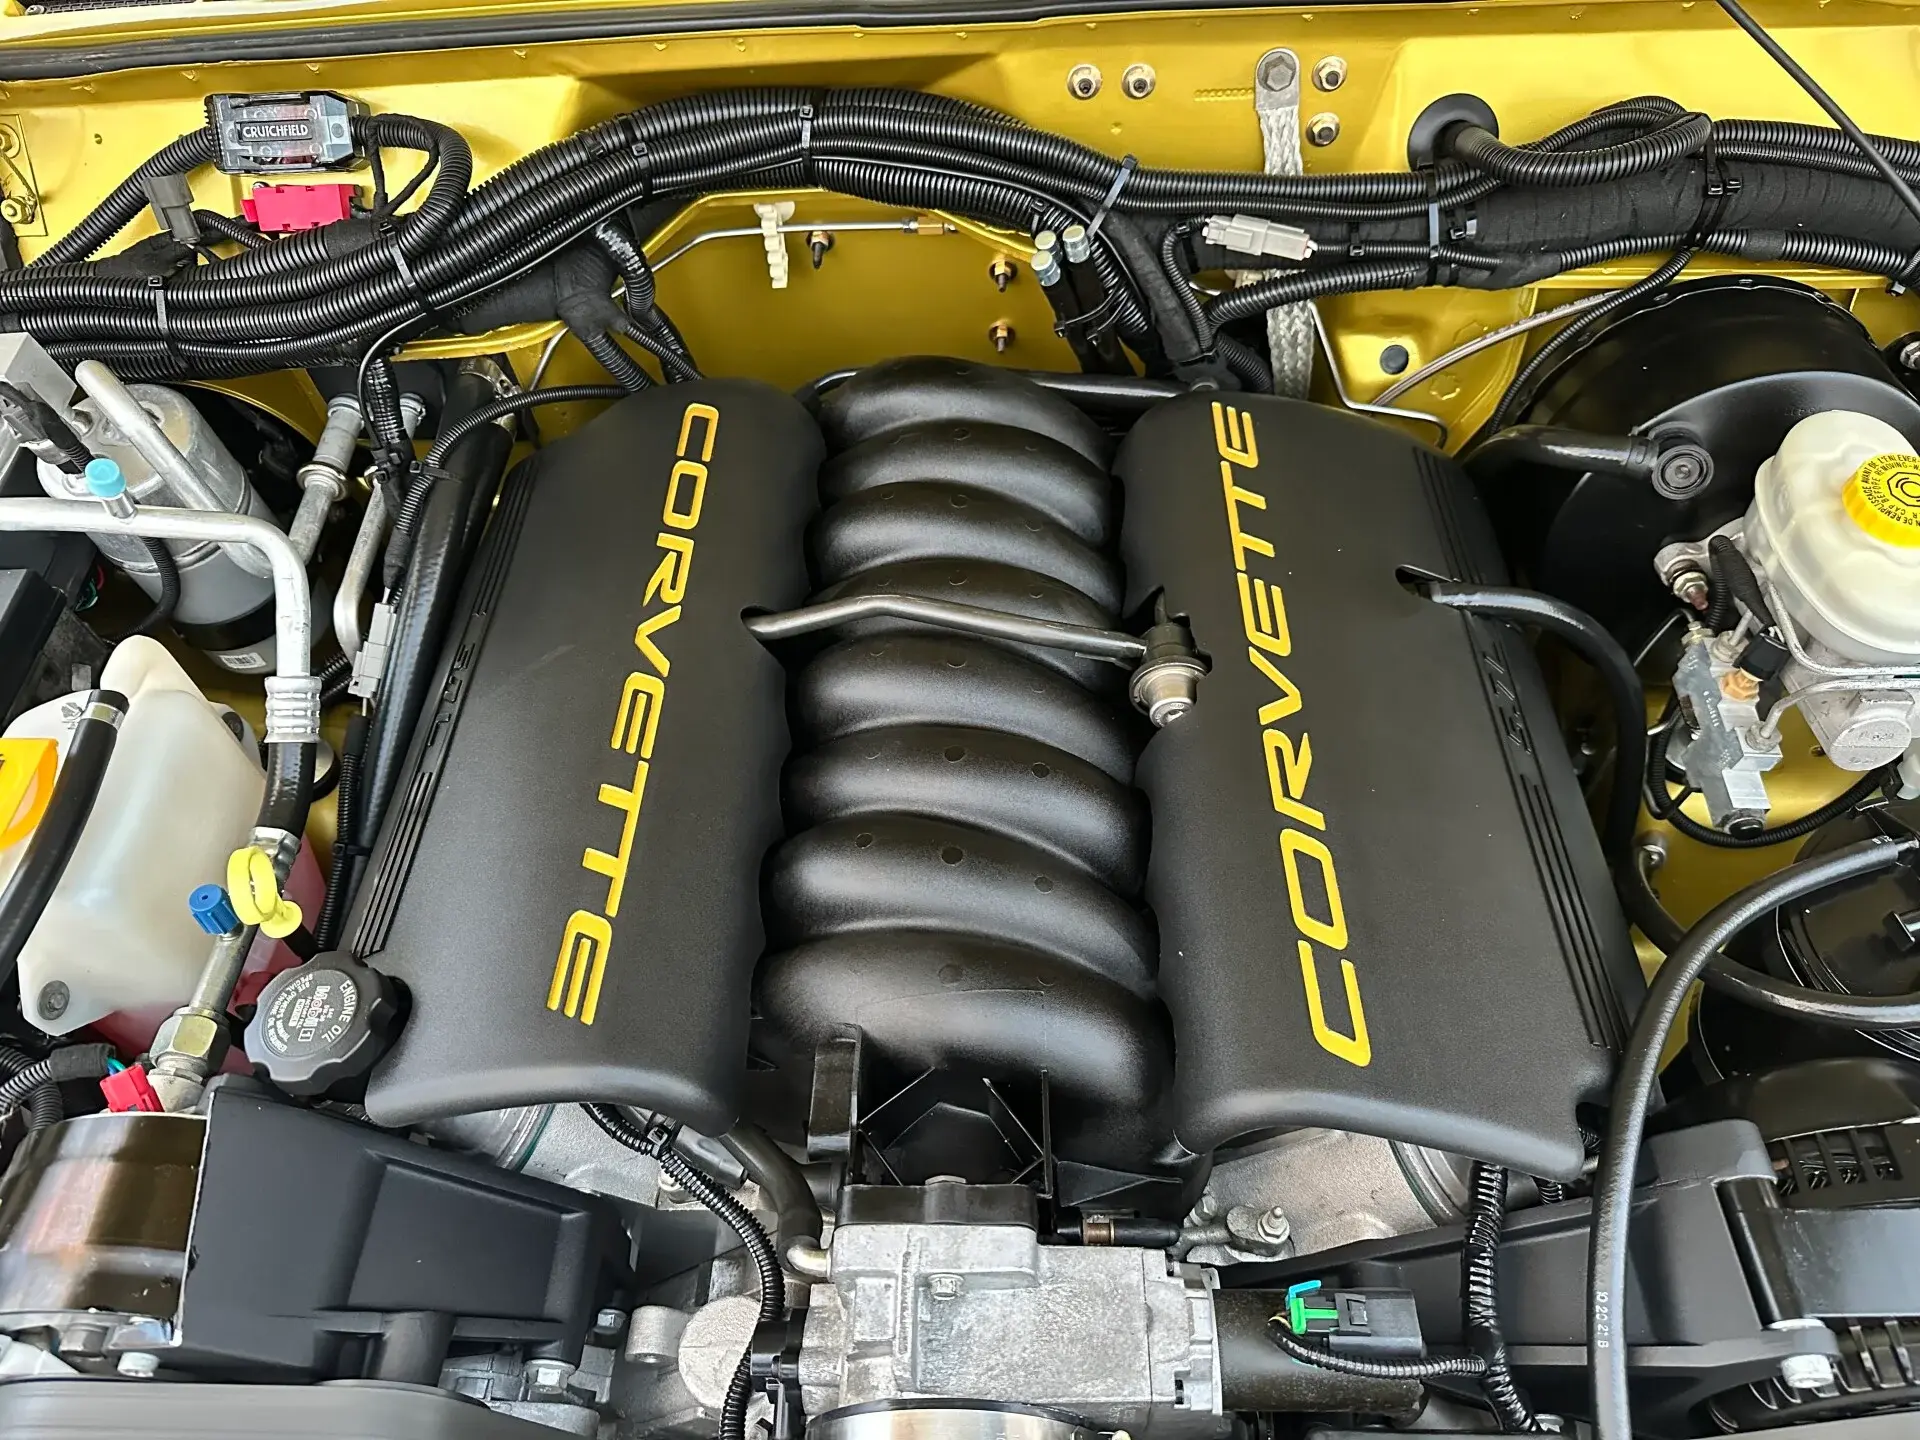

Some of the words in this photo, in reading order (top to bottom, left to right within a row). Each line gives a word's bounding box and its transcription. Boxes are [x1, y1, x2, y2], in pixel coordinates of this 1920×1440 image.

[242, 124, 309, 138] CRUTCHFIELD
[1871, 477, 1889, 503] BEFORE
[1862, 486, 1902, 521] REMPLISSAGE
[1888, 504, 1906, 515] CAP
[1903, 517, 1913, 525] DE
[547, 402, 720, 1025] CORVETTE
[1212, 401, 1371, 1067] CORVETTE
[286, 973, 313, 992] SPECIAL
[270, 992, 288, 1015] ENGINE
[303, 986, 331, 1027] Mobil
[339, 979, 356, 1022] ENGINE
[267, 1017, 276, 1028] OIL
[321, 1025, 342, 1042] OIL
[1595, 1305, 1608, 1321] 20
